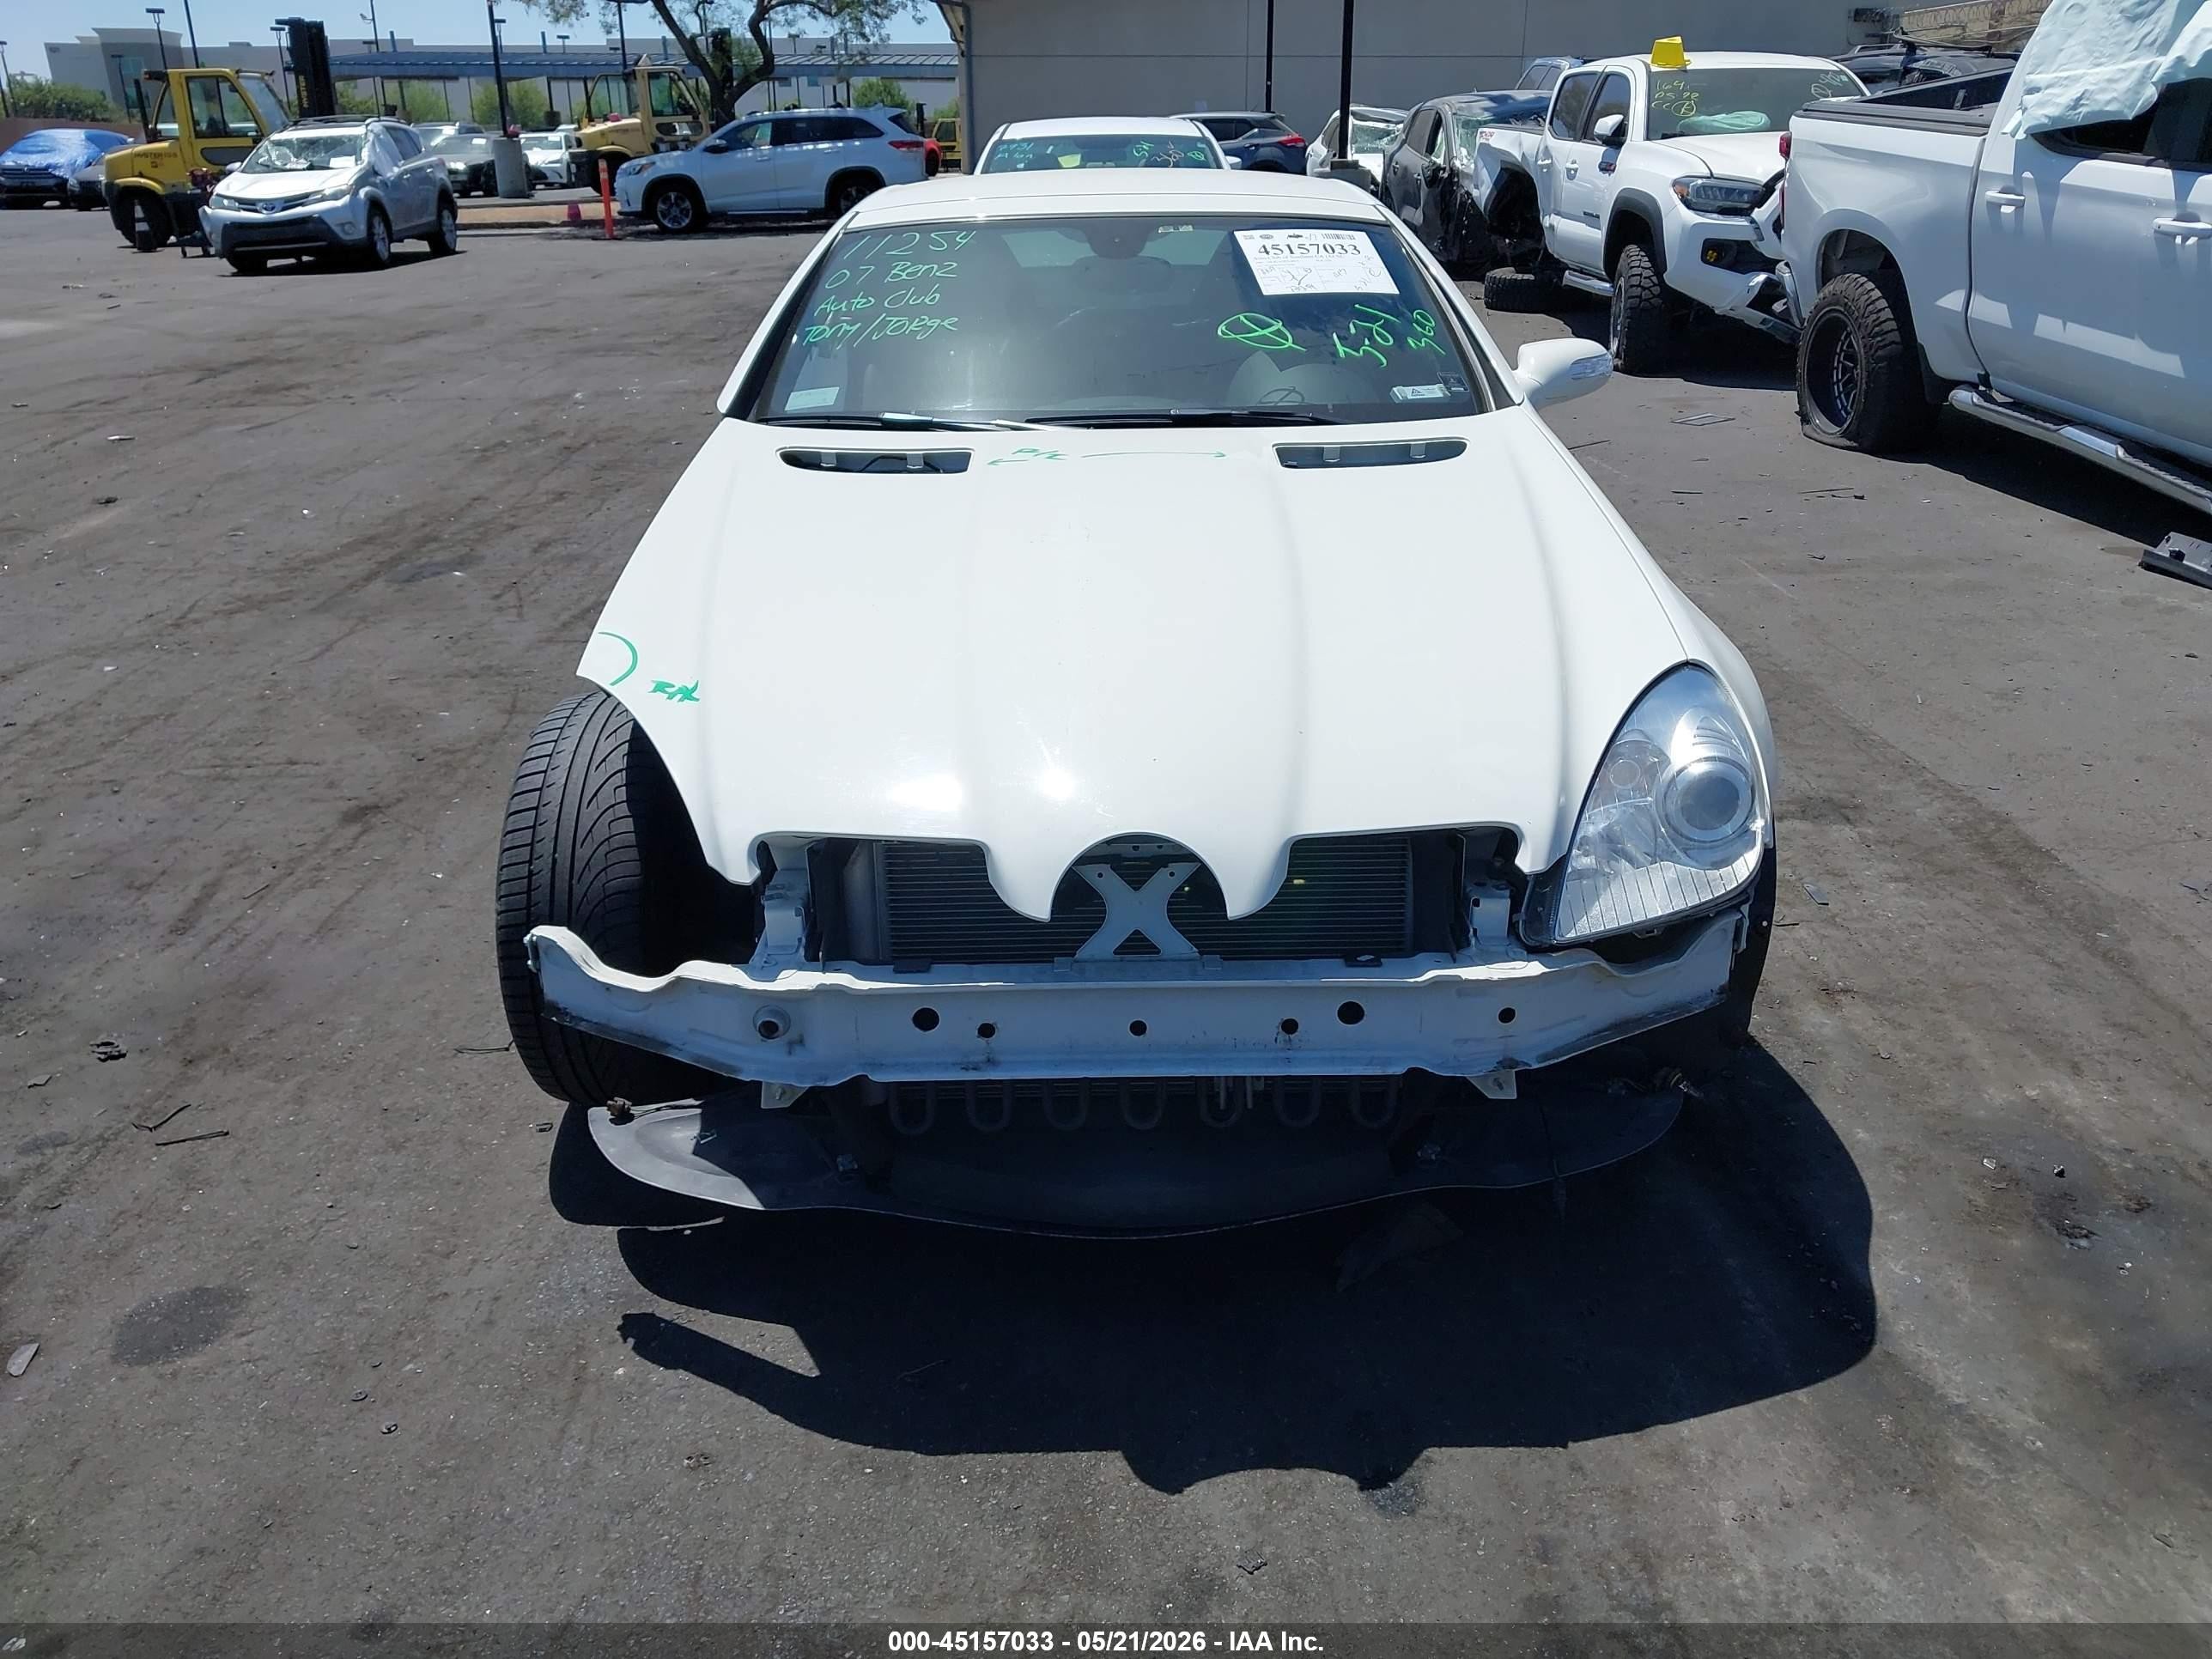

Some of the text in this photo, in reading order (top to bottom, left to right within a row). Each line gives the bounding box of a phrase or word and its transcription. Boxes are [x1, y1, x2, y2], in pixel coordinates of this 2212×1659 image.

[843, 230, 976, 259] 11254
[1258, 242, 1361, 256] 45157033
[814, 283, 940, 316] Auto Club
